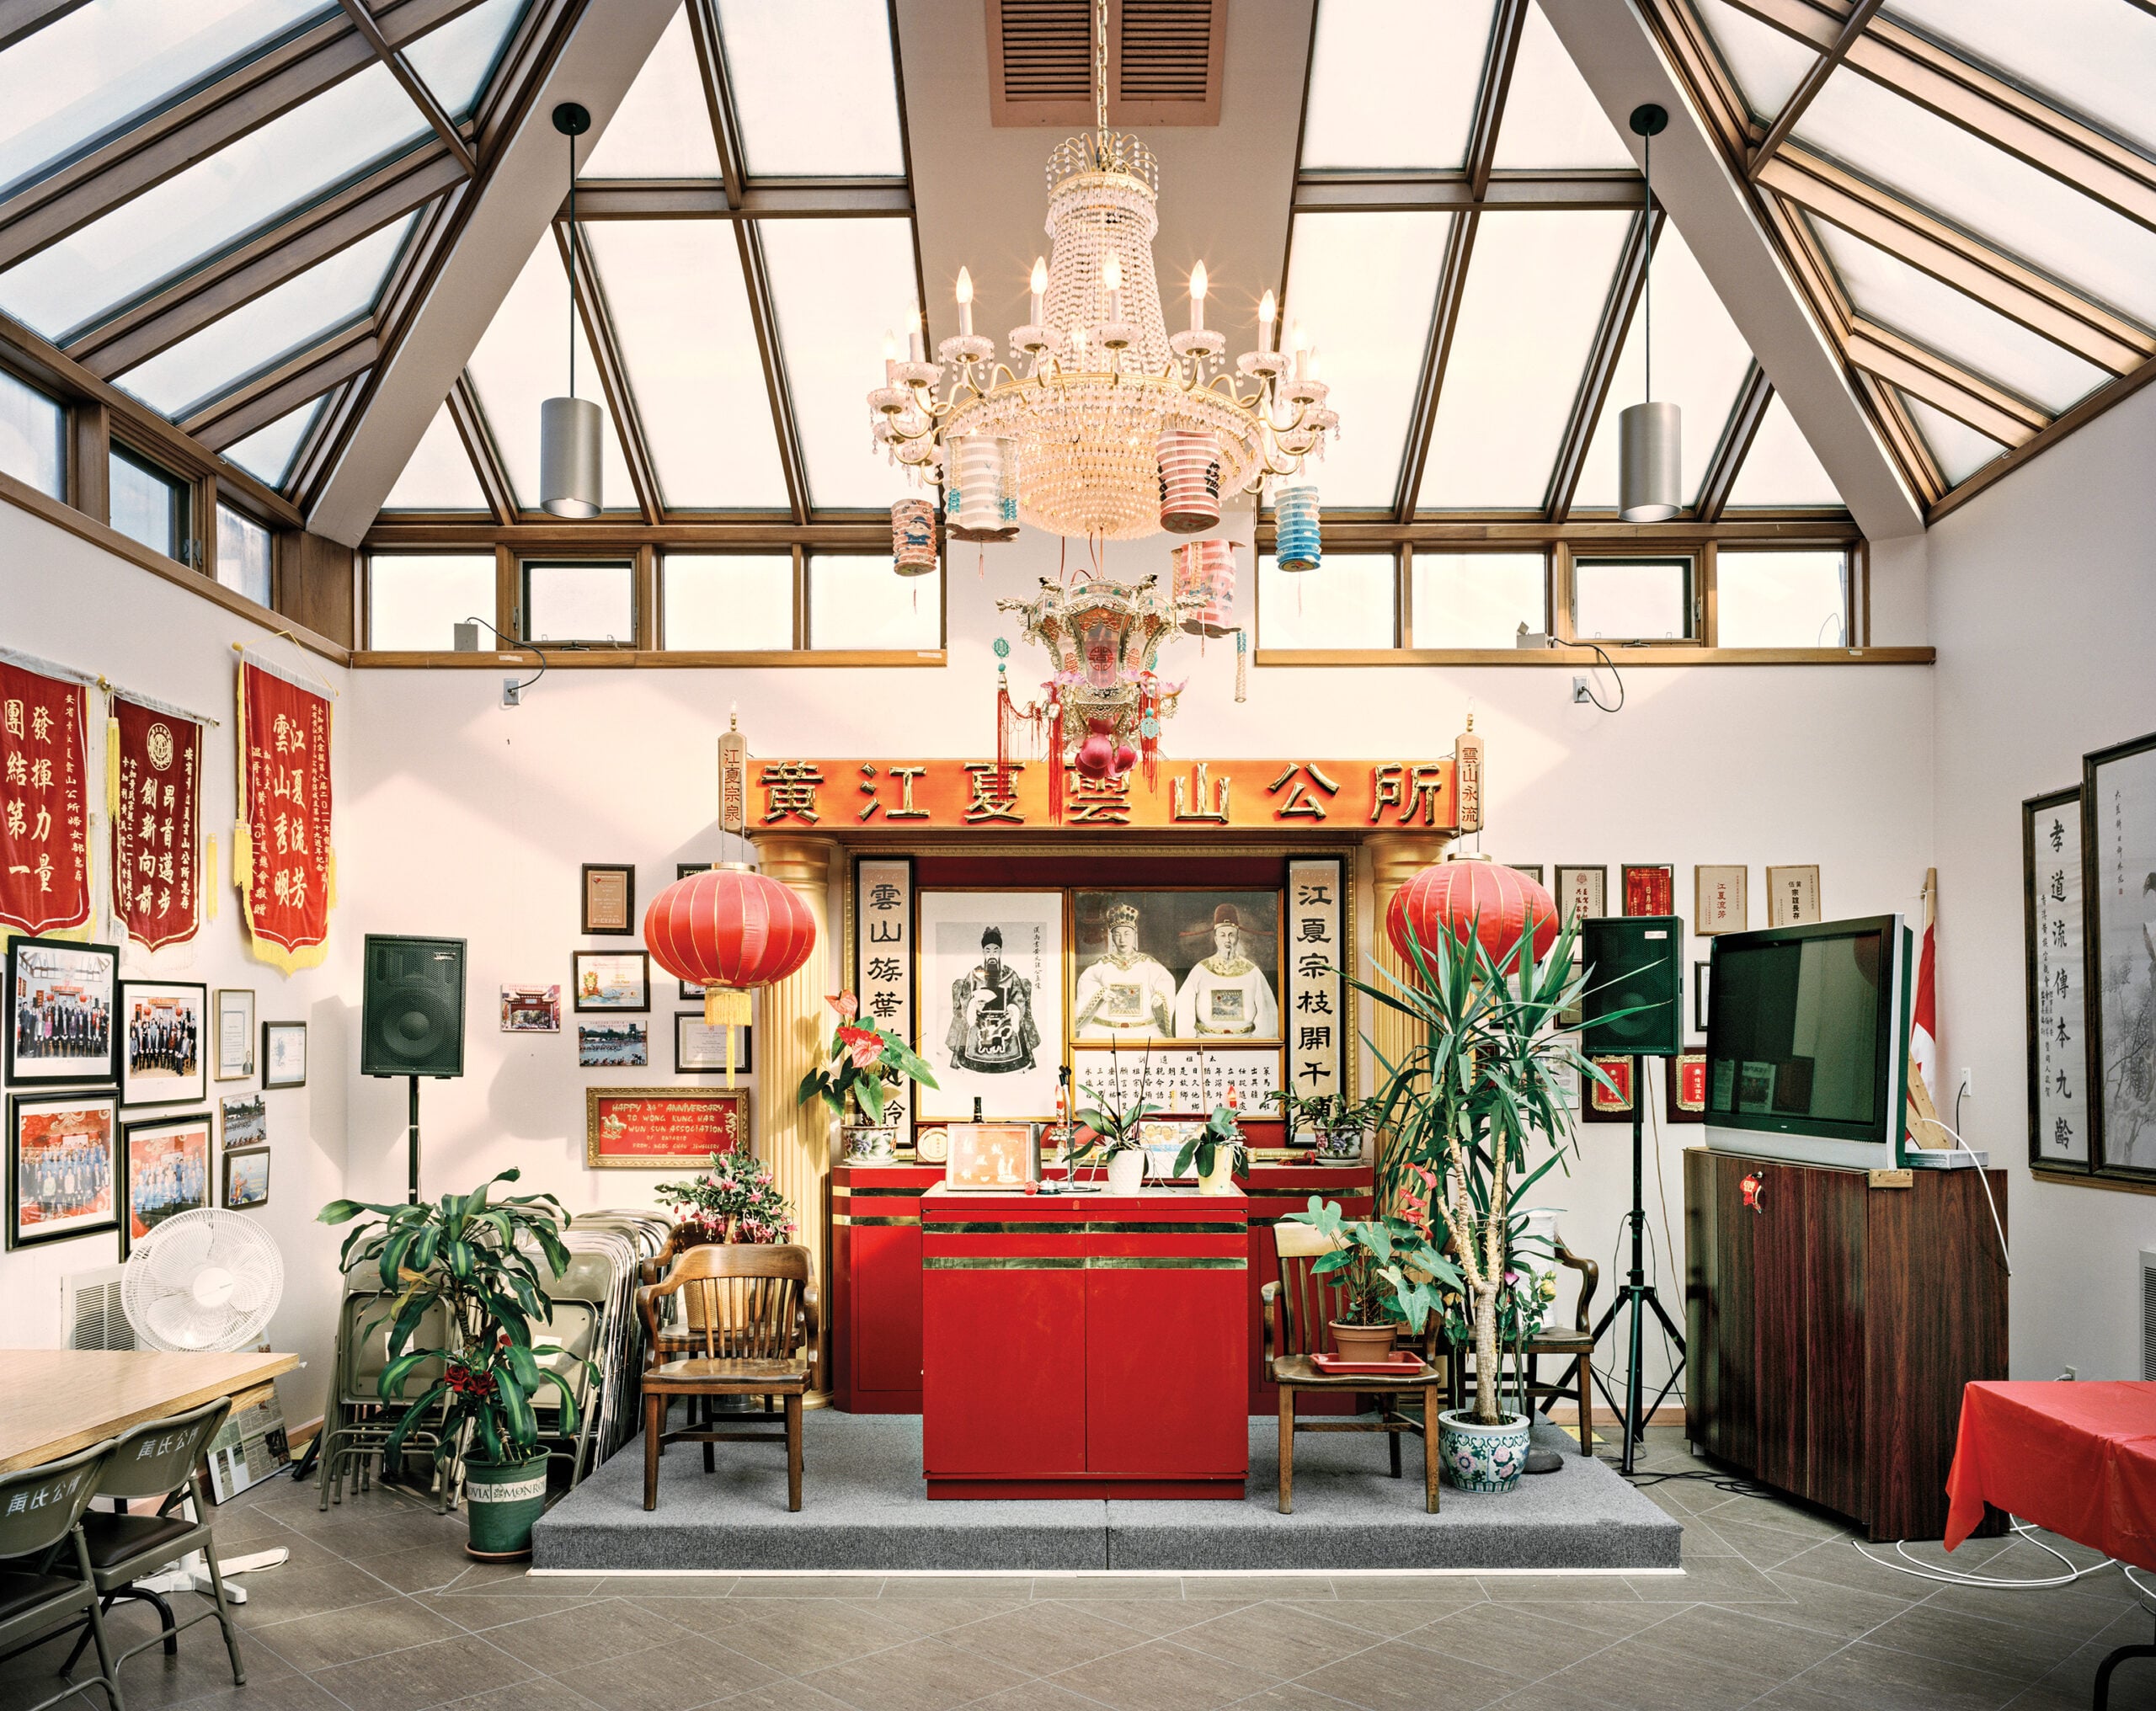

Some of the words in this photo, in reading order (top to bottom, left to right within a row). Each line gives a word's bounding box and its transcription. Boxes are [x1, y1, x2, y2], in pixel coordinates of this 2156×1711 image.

[4, 699, 31, 875] 團結第一
[31, 706, 55, 893] 發揮力量
[289, 719, 308, 909] 江夏流芳
[723, 749, 741, 822] 江夏宗泉
[1461, 747, 1478, 823] 雲山永流
[135, 777, 158, 917] 創新向前
[157, 785, 175, 919] 昂首邁步
[1717, 882, 1726, 919] 江夏流芳
[612, 1103, 642, 1112] HAPPY
[666, 1102, 724, 1112] ANNIVERSARY
[670, 1124, 723, 1133] ASSOCIATION
